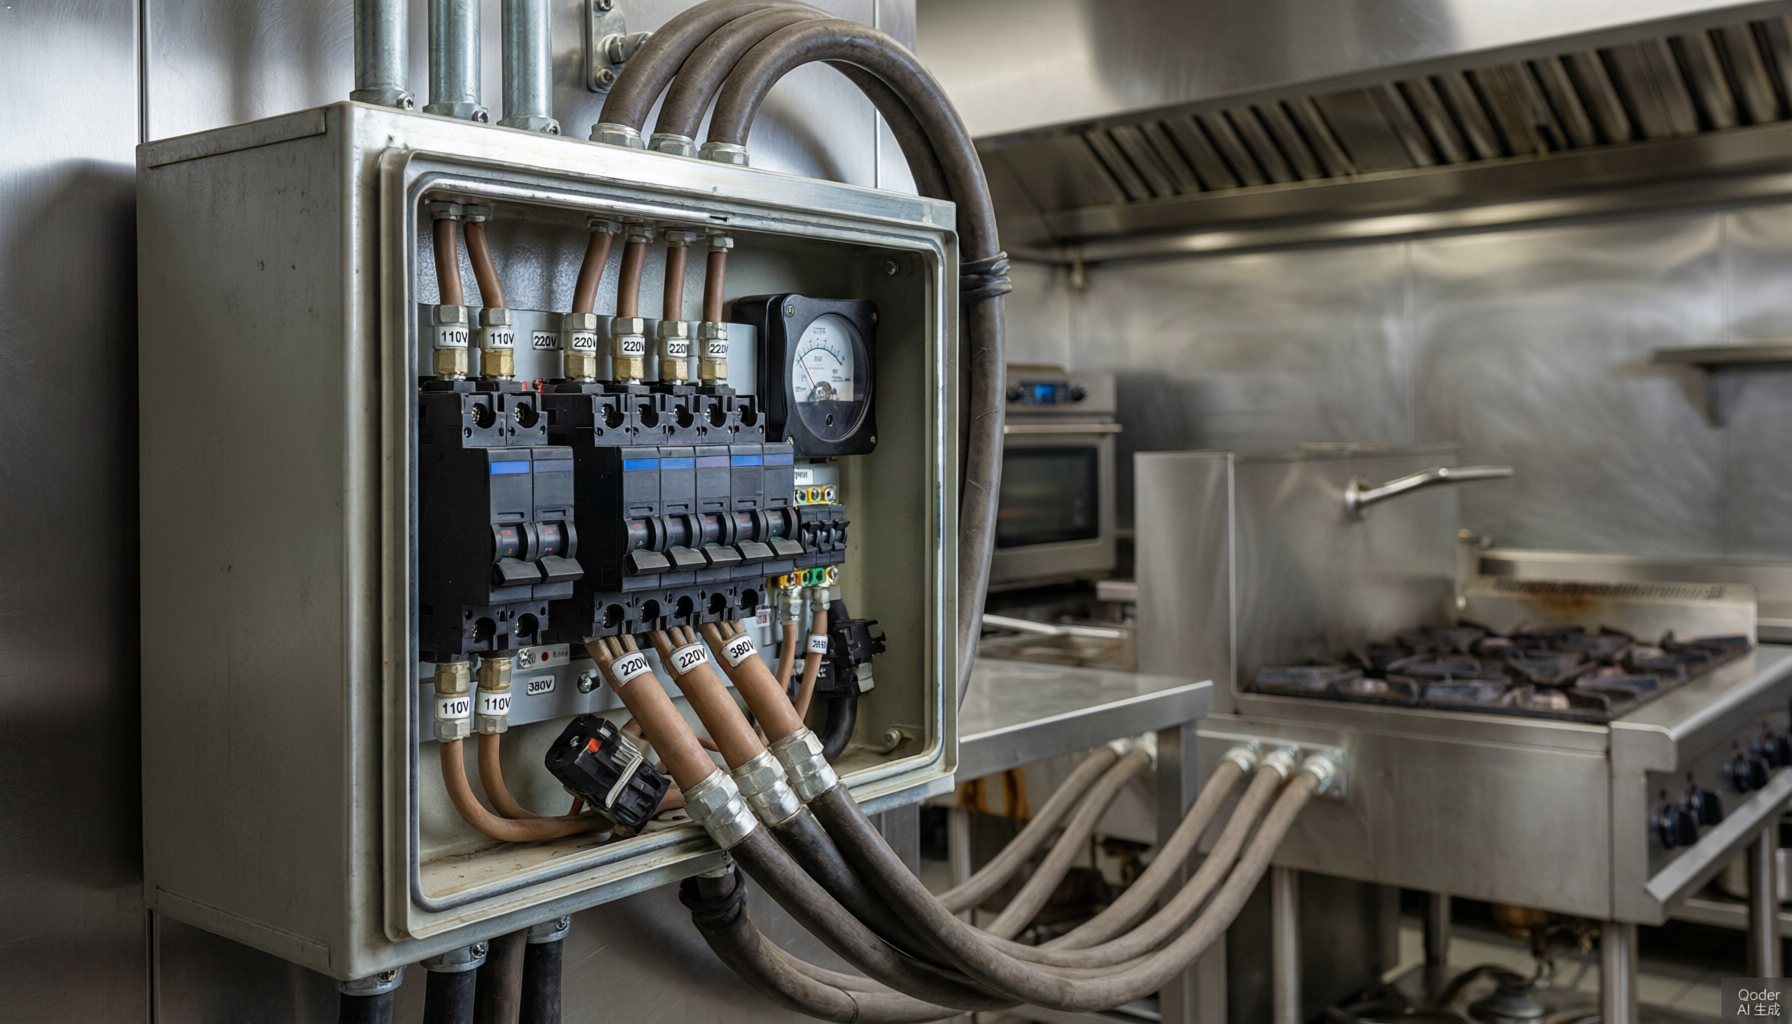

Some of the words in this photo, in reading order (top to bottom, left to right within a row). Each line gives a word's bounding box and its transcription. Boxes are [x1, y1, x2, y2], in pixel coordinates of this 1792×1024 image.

[441, 330, 468, 344] 110V
[490, 332, 515, 345] 110V
[533, 335, 557, 348] 220V
[730, 640, 754, 659] 380V
[679, 648, 706, 668] 220V
[621, 656, 648, 676] 220V
[528, 679, 553, 692] 380V
[442, 700, 469, 714] 110V
[484, 696, 511, 710] 110V
